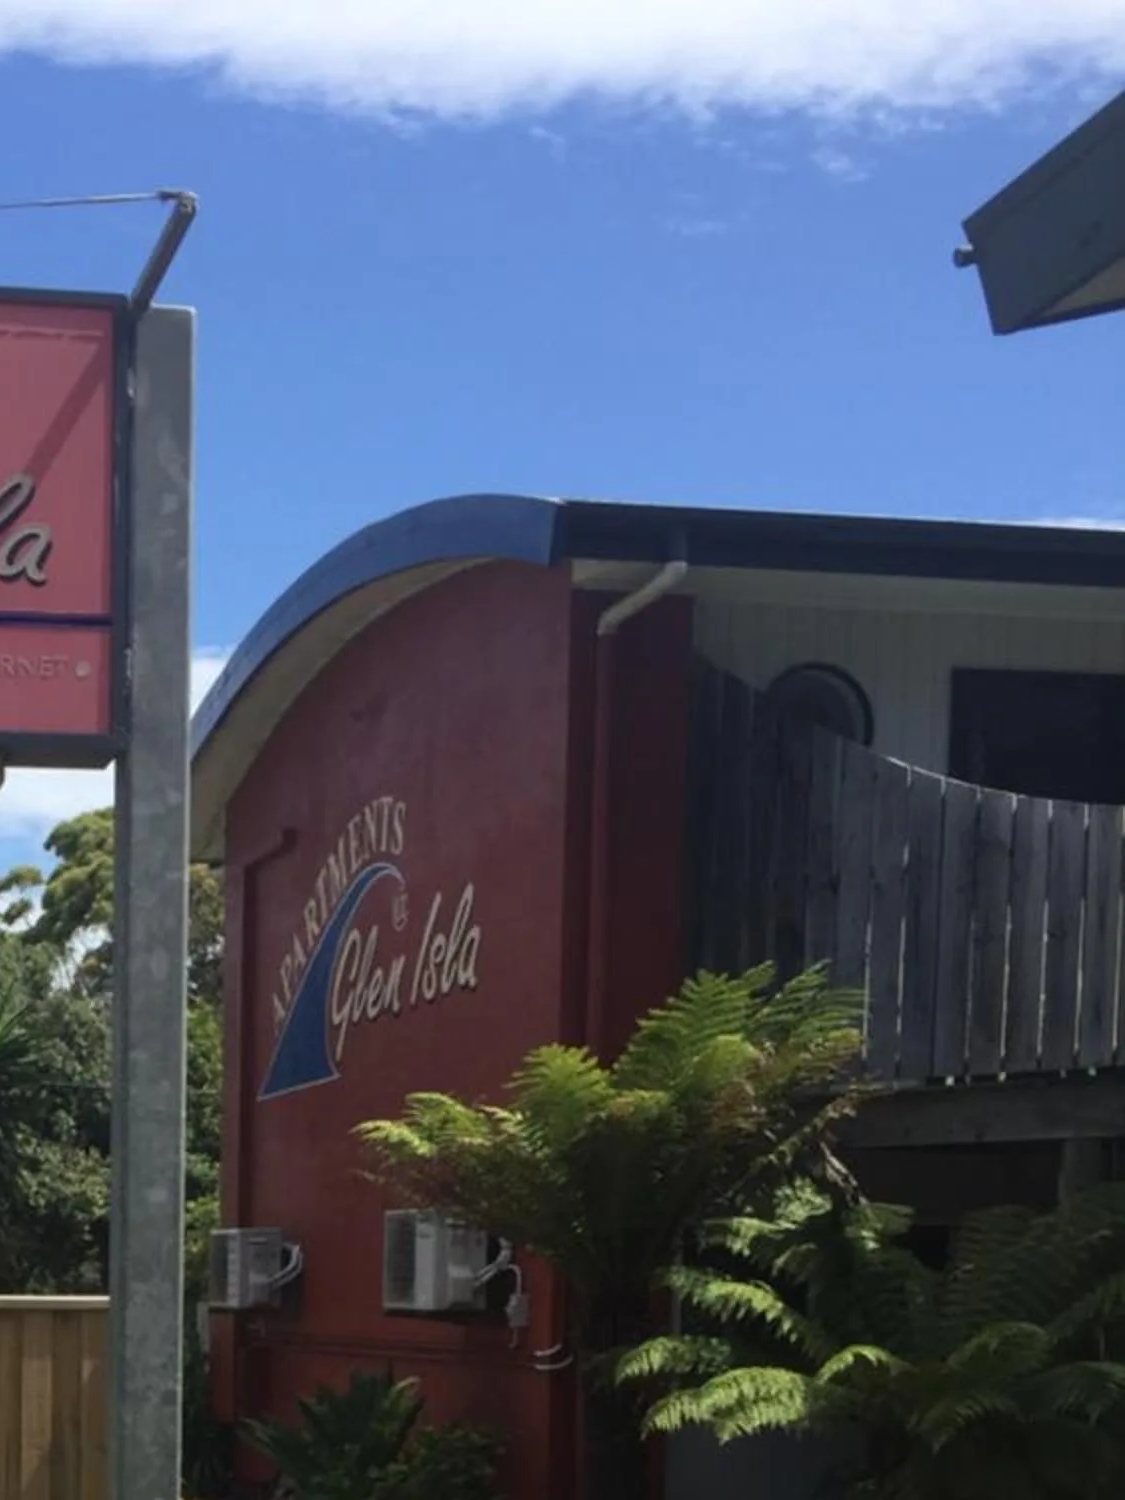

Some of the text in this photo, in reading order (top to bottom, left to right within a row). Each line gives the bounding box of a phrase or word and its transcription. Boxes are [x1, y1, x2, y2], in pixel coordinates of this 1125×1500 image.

[272, 795, 407, 1035] APARTMENTS
[331, 879, 482, 1062] Glen Isla
